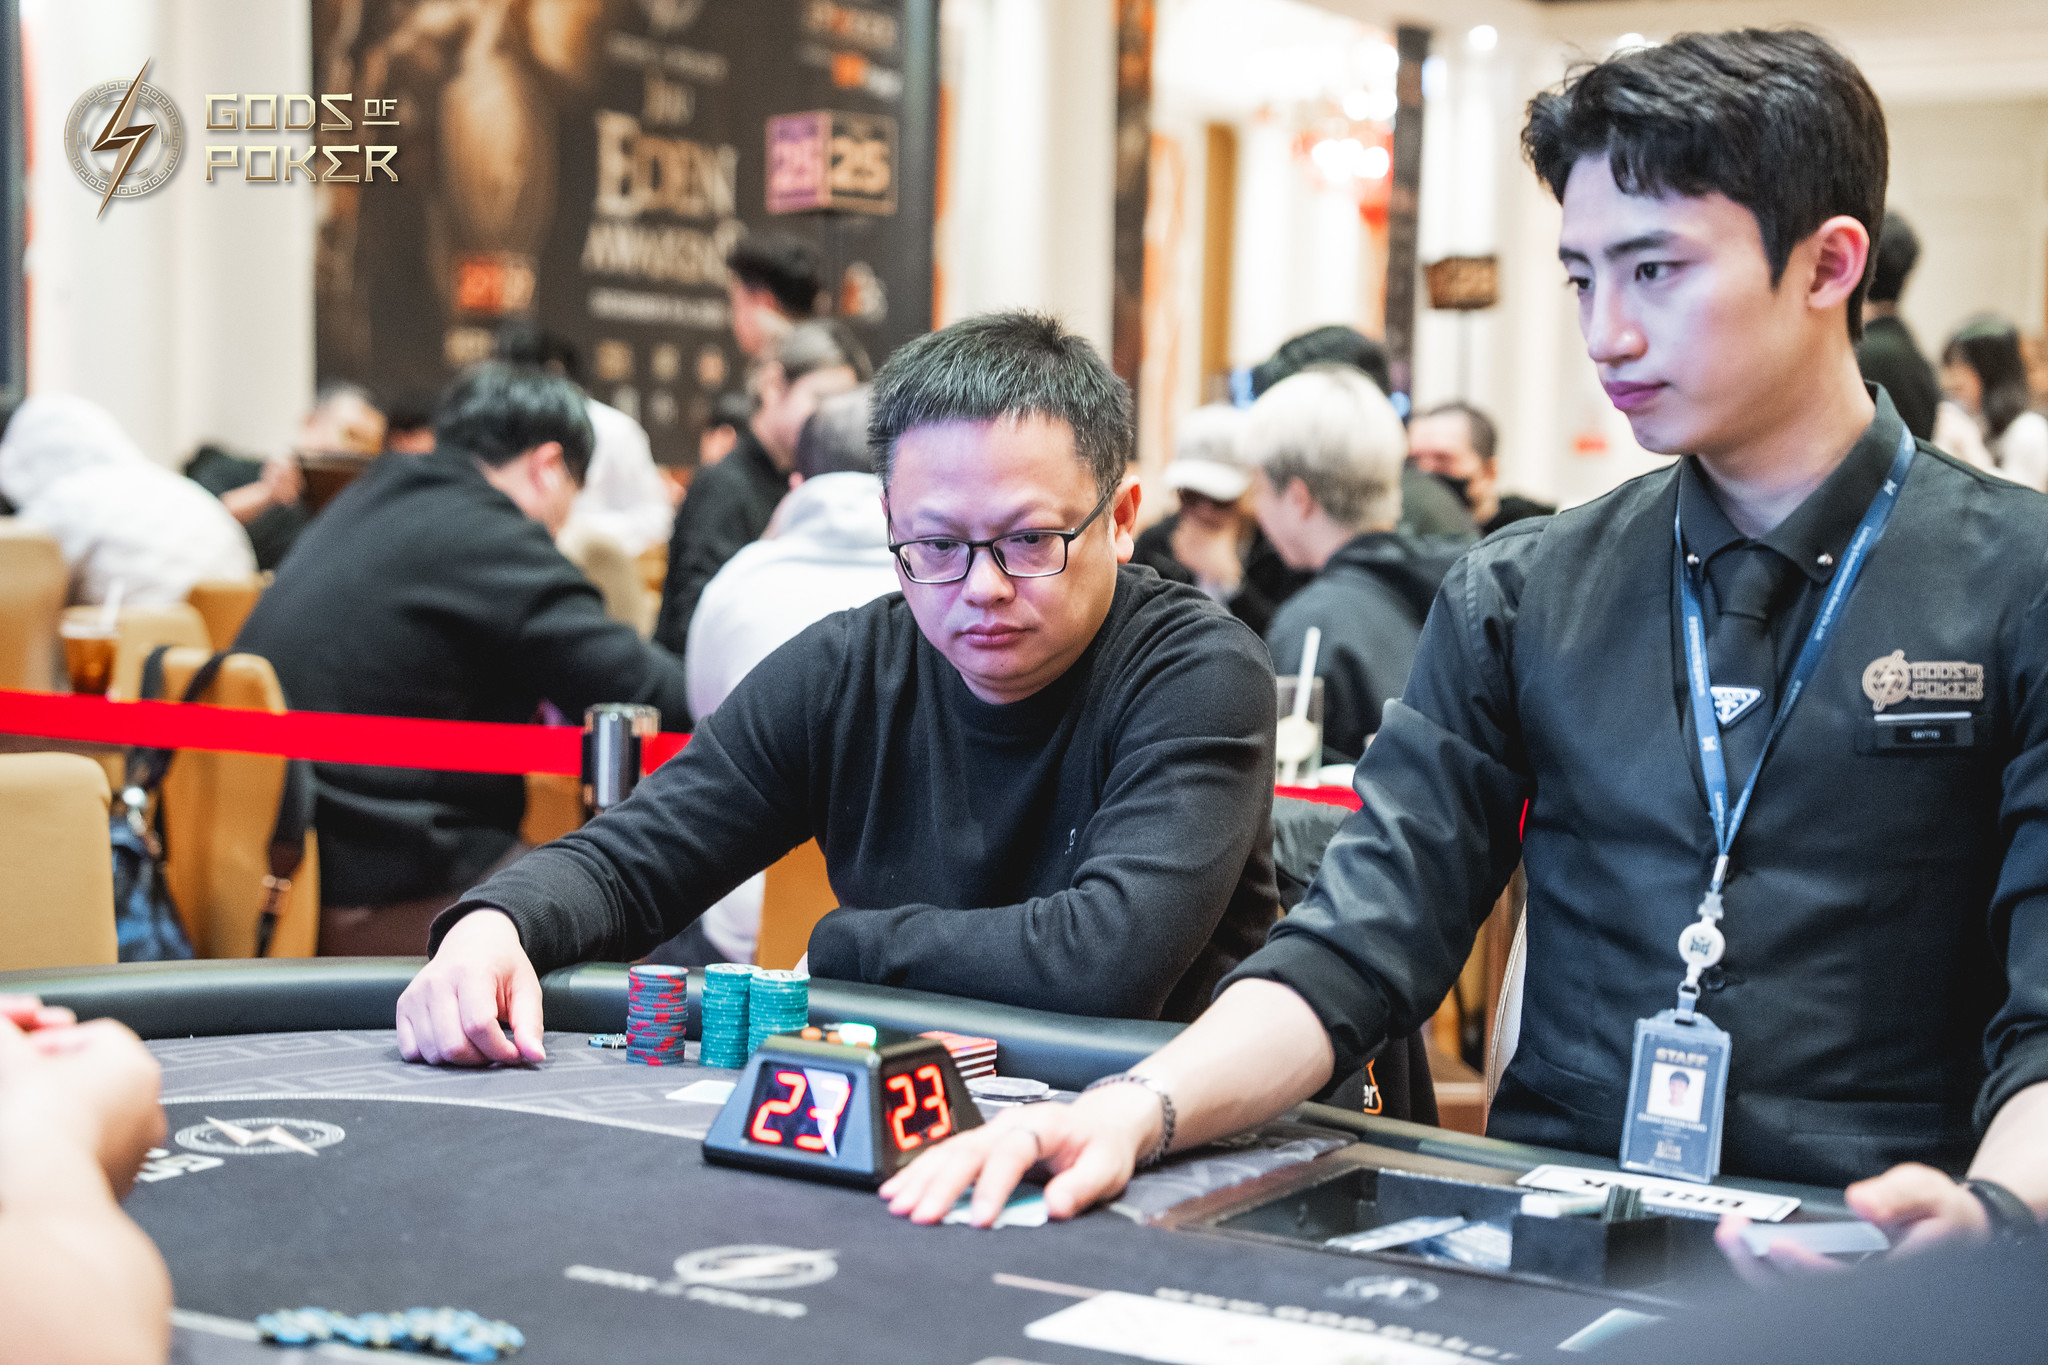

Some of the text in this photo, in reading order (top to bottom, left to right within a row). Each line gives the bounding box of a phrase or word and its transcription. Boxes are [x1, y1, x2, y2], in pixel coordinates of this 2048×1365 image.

[1655, 1047, 1709, 1067] STAFF
[751, 1070, 851, 1151] 23
[886, 1064, 951, 1150] 23
